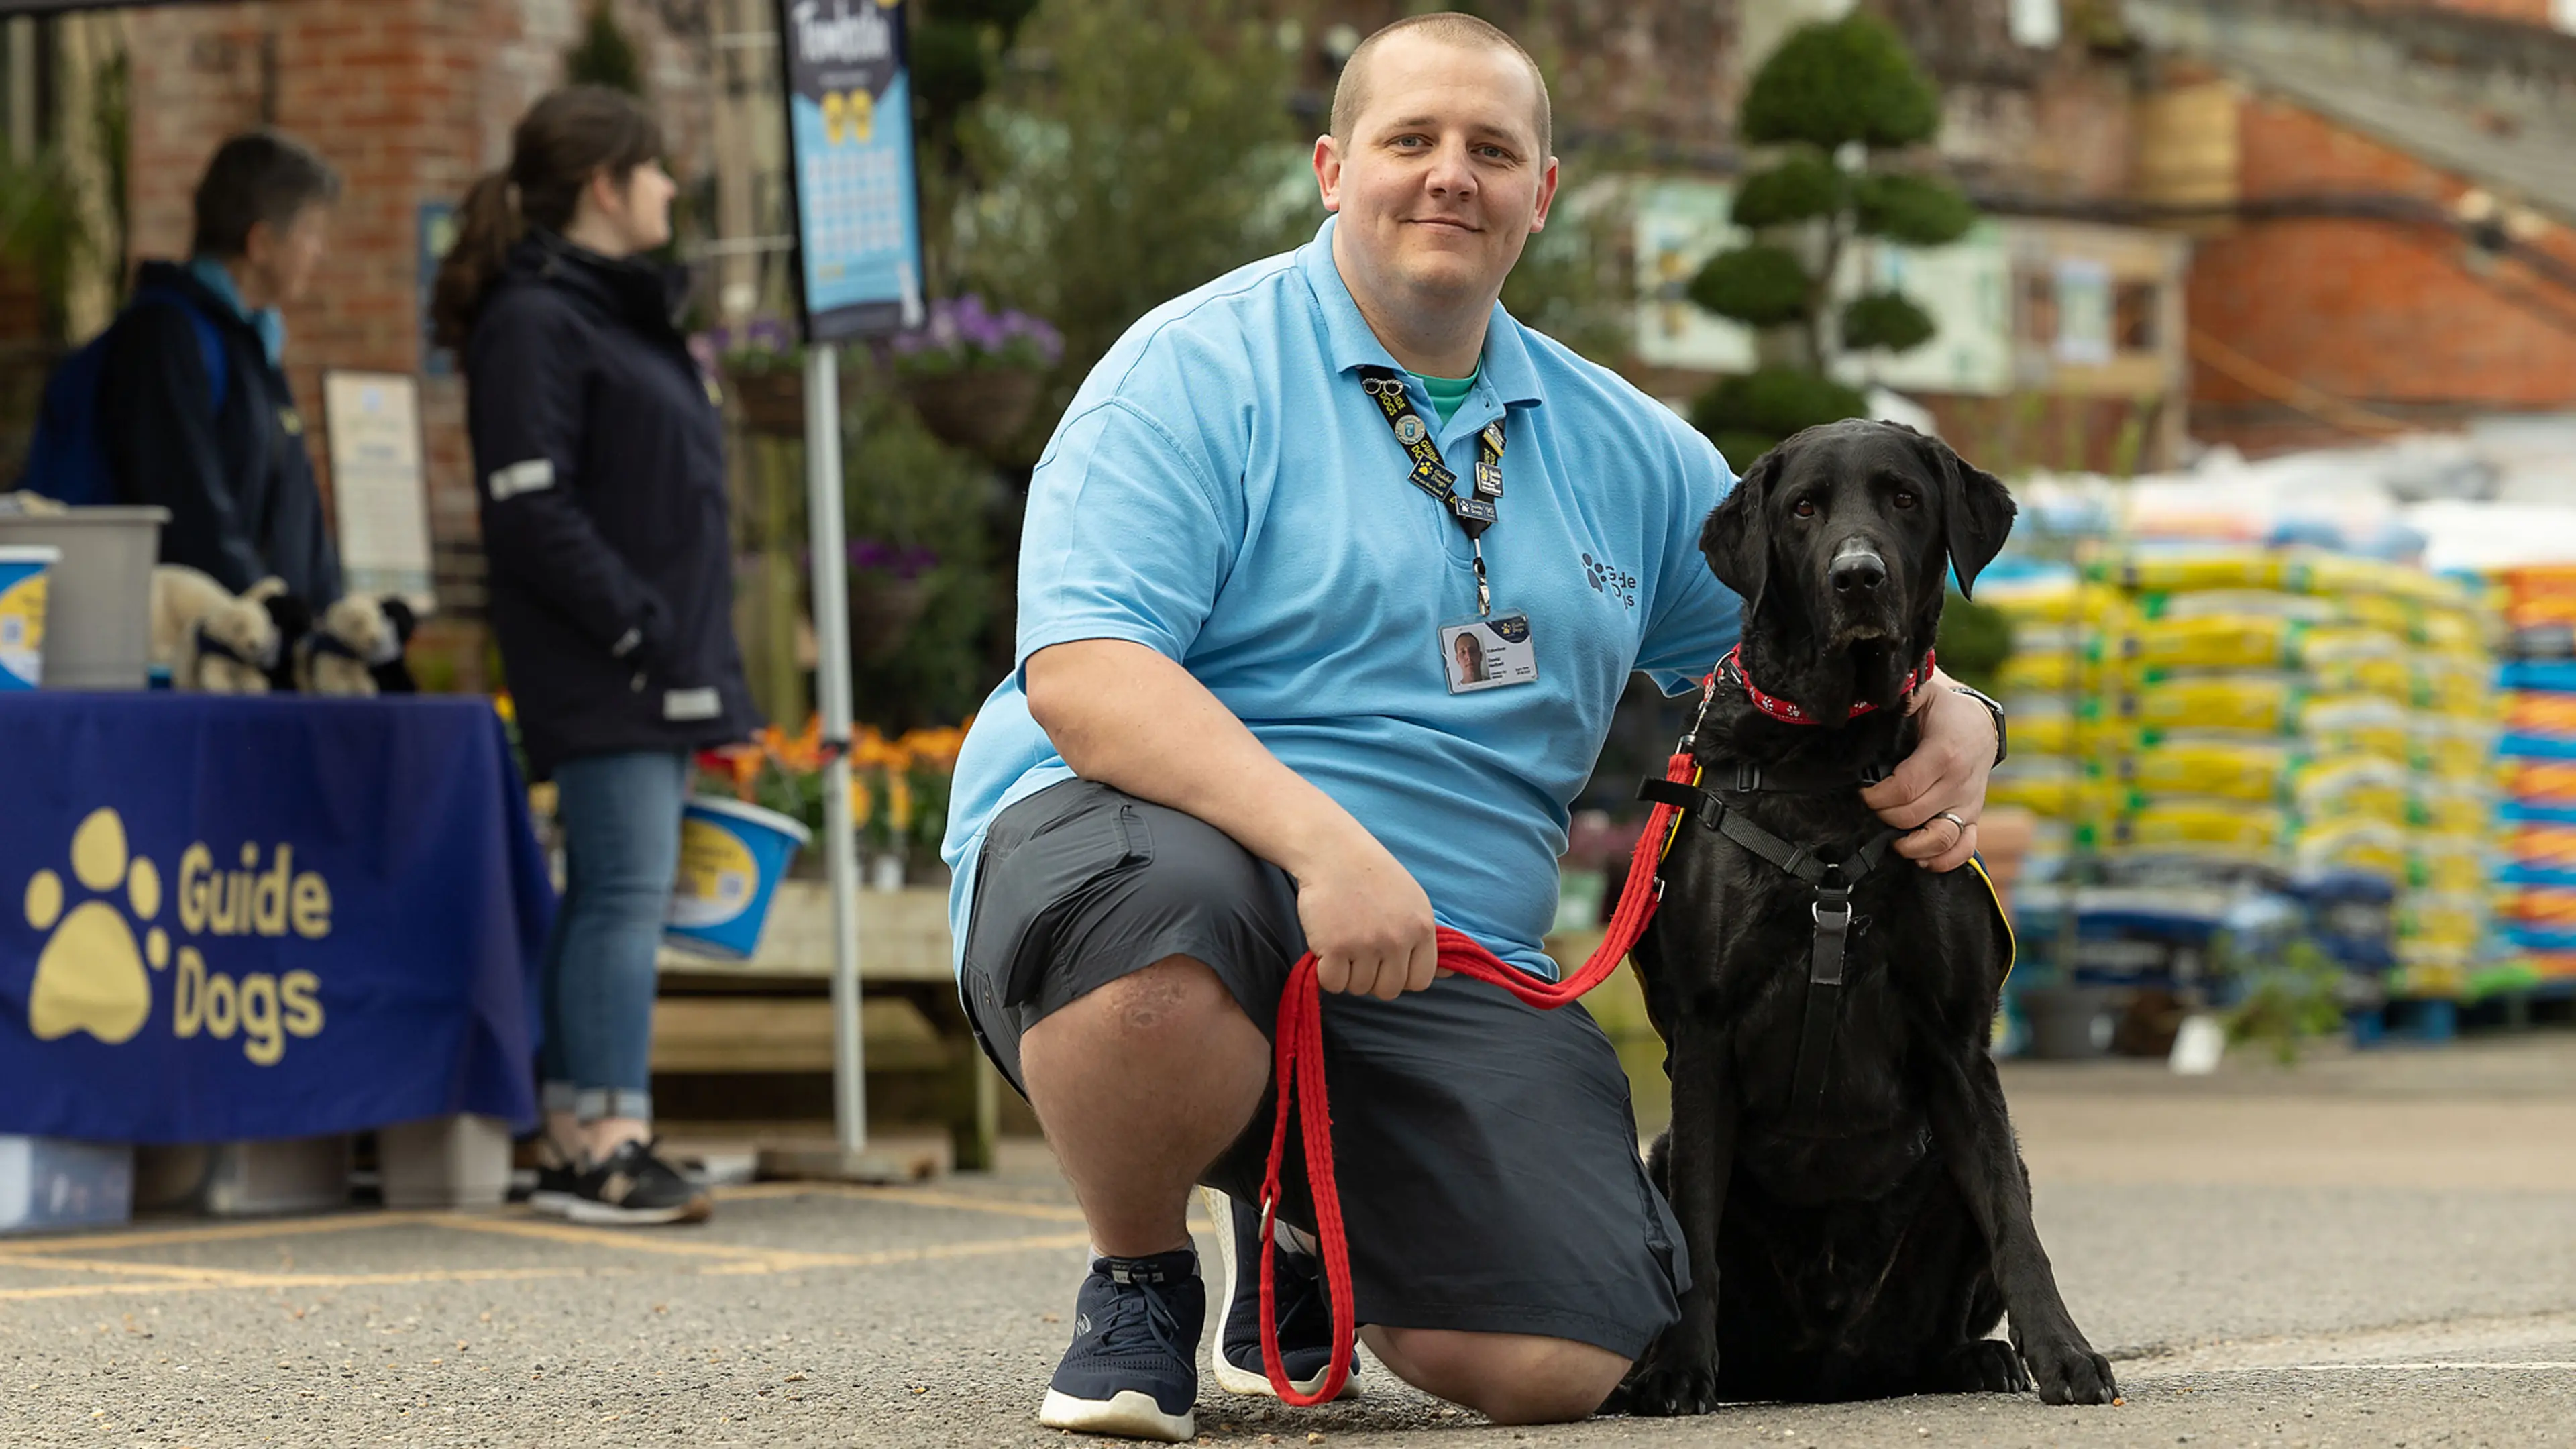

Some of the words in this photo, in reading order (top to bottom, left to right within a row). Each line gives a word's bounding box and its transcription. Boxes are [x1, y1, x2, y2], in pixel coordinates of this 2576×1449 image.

[1411, 445, 1424, 459] DO
[1605, 566, 1637, 589] Gde
[178, 840, 332, 938] Guide
[173, 944, 325, 1067] Dogs
